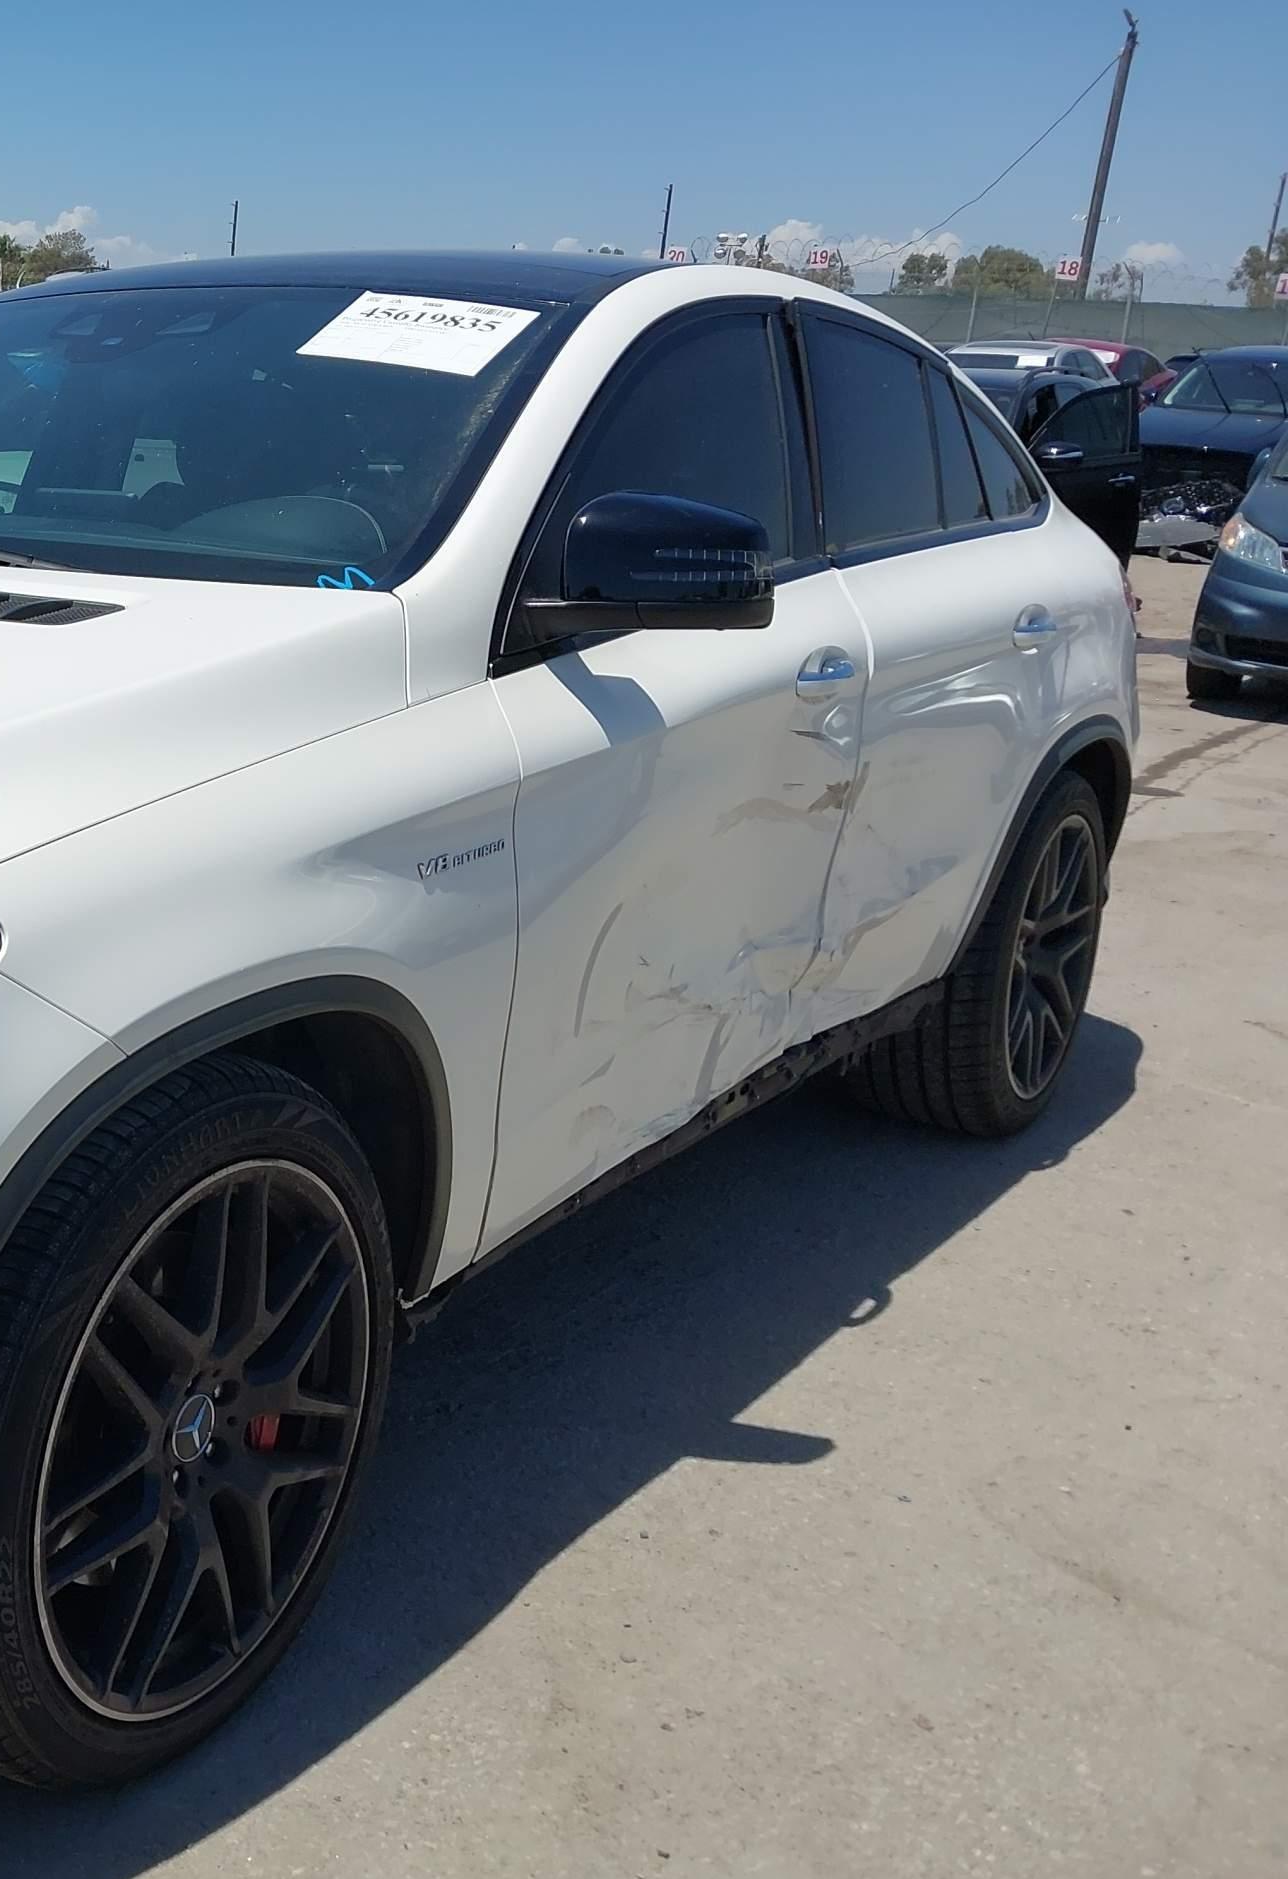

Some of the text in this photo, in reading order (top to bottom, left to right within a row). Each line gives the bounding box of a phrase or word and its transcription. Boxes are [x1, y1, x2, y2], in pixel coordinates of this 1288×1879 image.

[811, 250, 829, 265] 19
[1057, 260, 1080, 276] 18
[360, 306, 503, 332] 45619835
[416, 838, 505, 880] V8 BITURBO
[0, 1535, 42, 1711] 285/40R22
